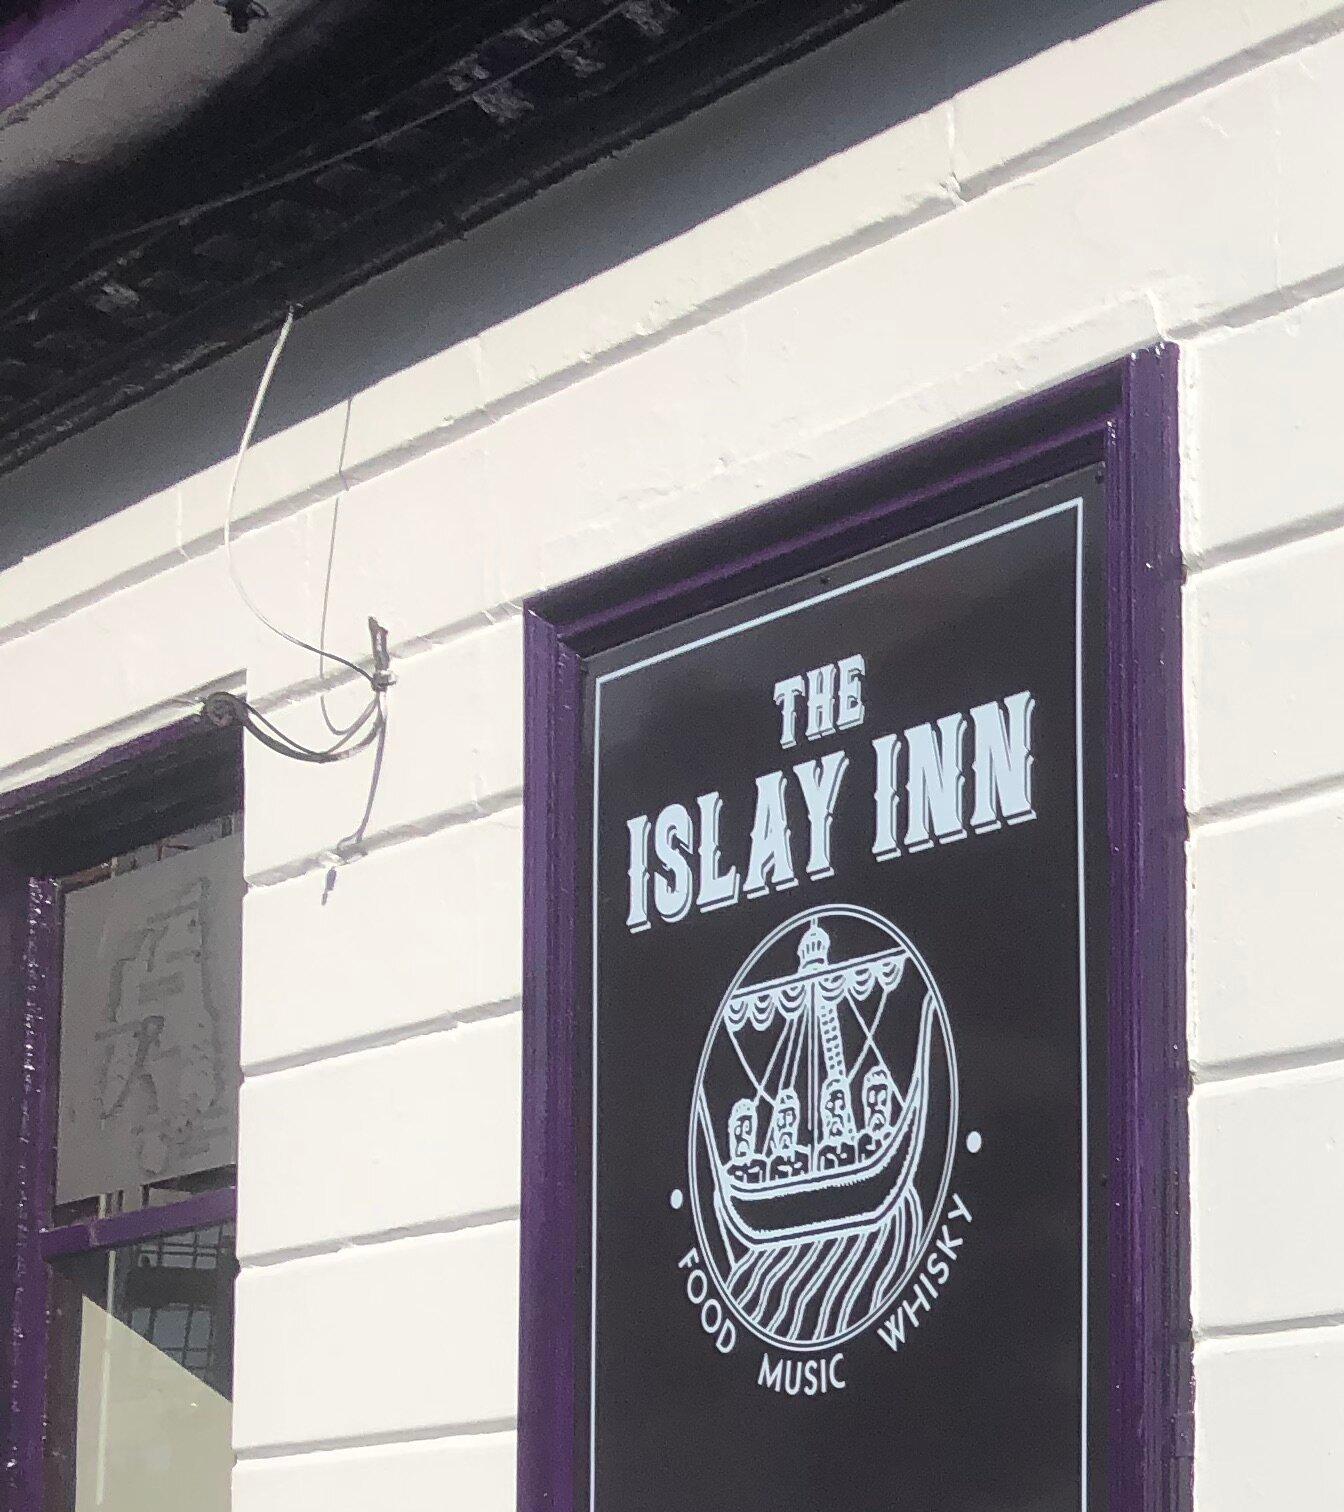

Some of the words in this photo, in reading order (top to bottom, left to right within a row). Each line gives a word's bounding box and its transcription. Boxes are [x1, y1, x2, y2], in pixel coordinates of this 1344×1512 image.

[773, 654, 865, 749] THE
[626, 750, 849, 933] ISLAY
[872, 690, 1037, 862] INN
[678, 1247, 736, 1353] FOOD
[758, 1353, 845, 1395] MUSIC
[877, 1194, 972, 1351] WHISKY
